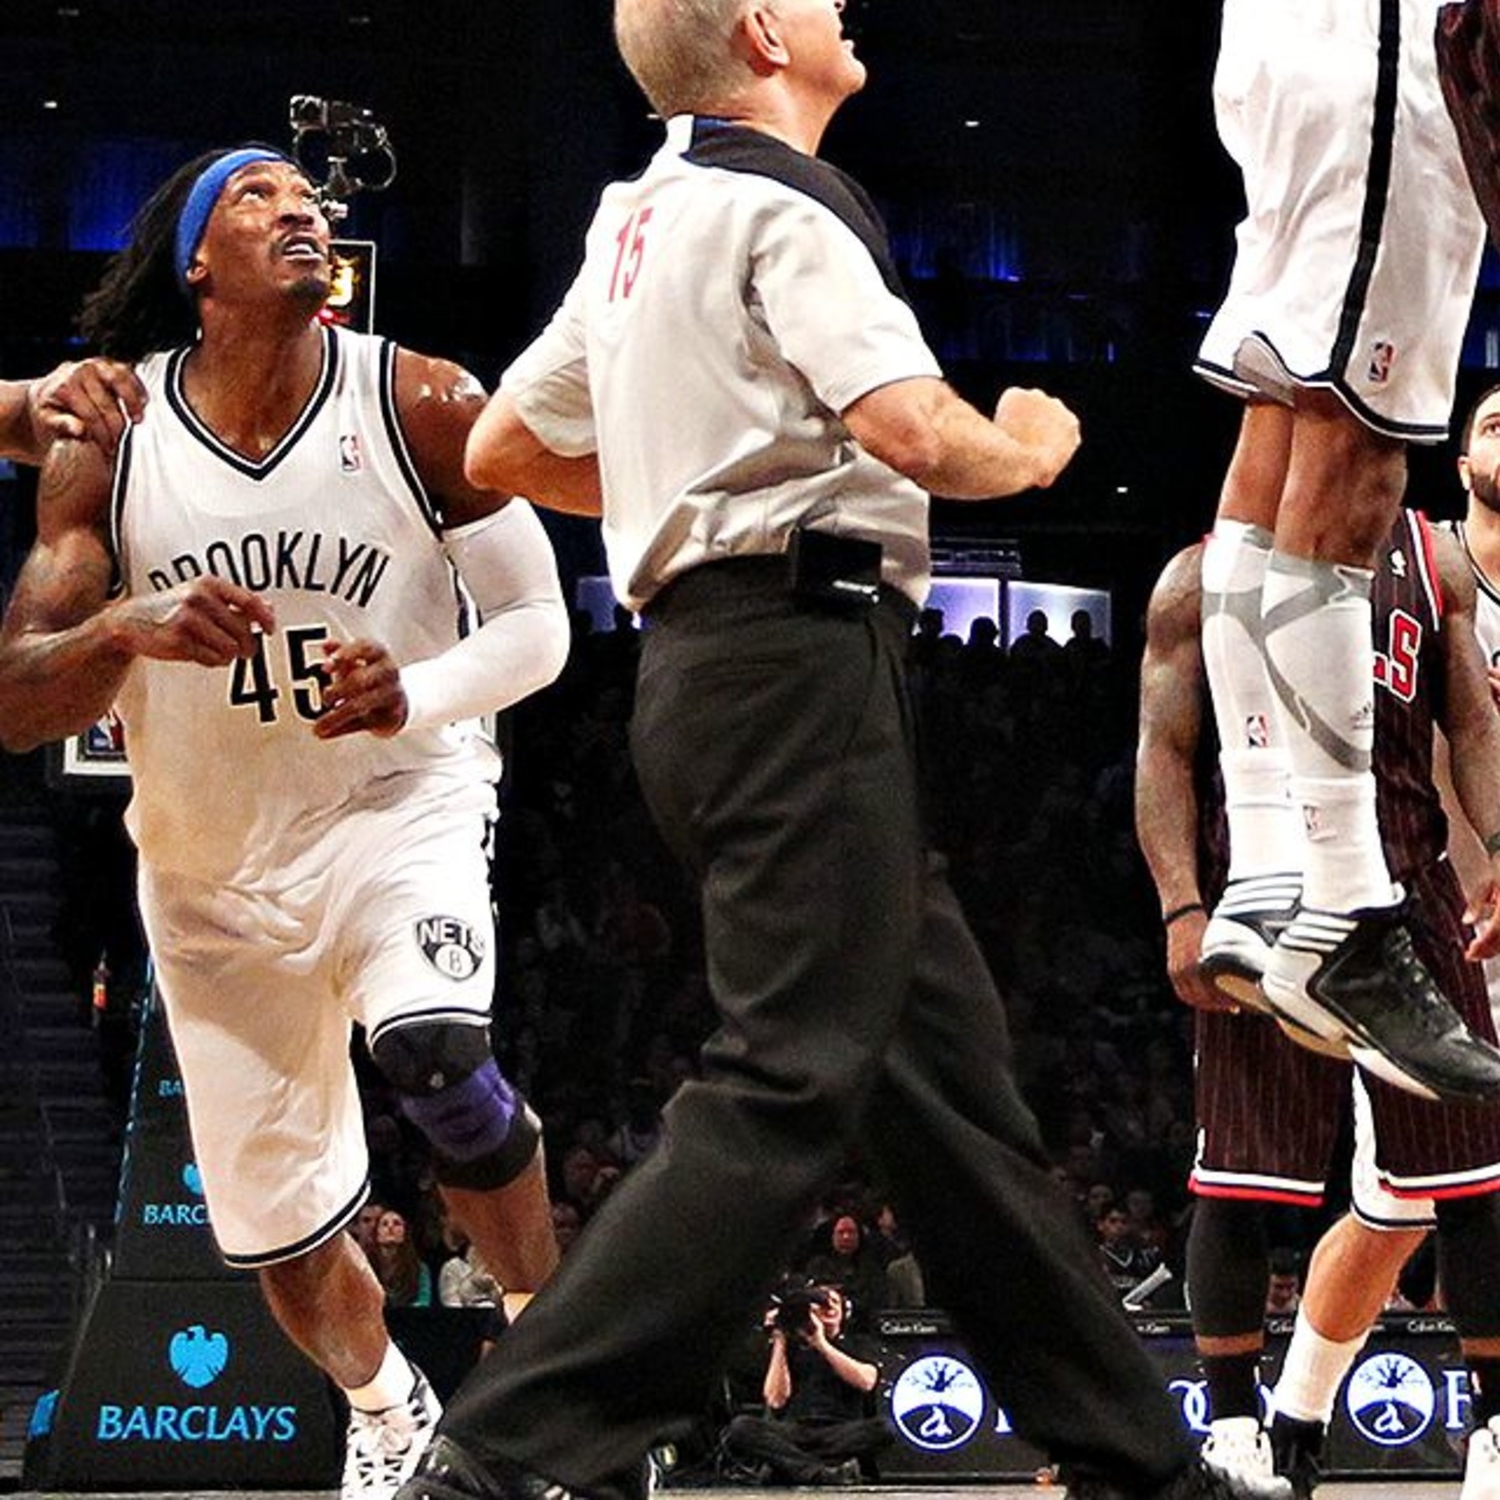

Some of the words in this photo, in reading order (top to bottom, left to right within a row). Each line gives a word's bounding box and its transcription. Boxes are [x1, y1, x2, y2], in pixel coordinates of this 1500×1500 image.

[608, 206, 655, 303] 15
[229, 626, 334, 722] 45
[416, 917, 485, 958] NETS
[144, 1204, 210, 1225] BARC
[98, 1405, 297, 1442] BARCLAYS
